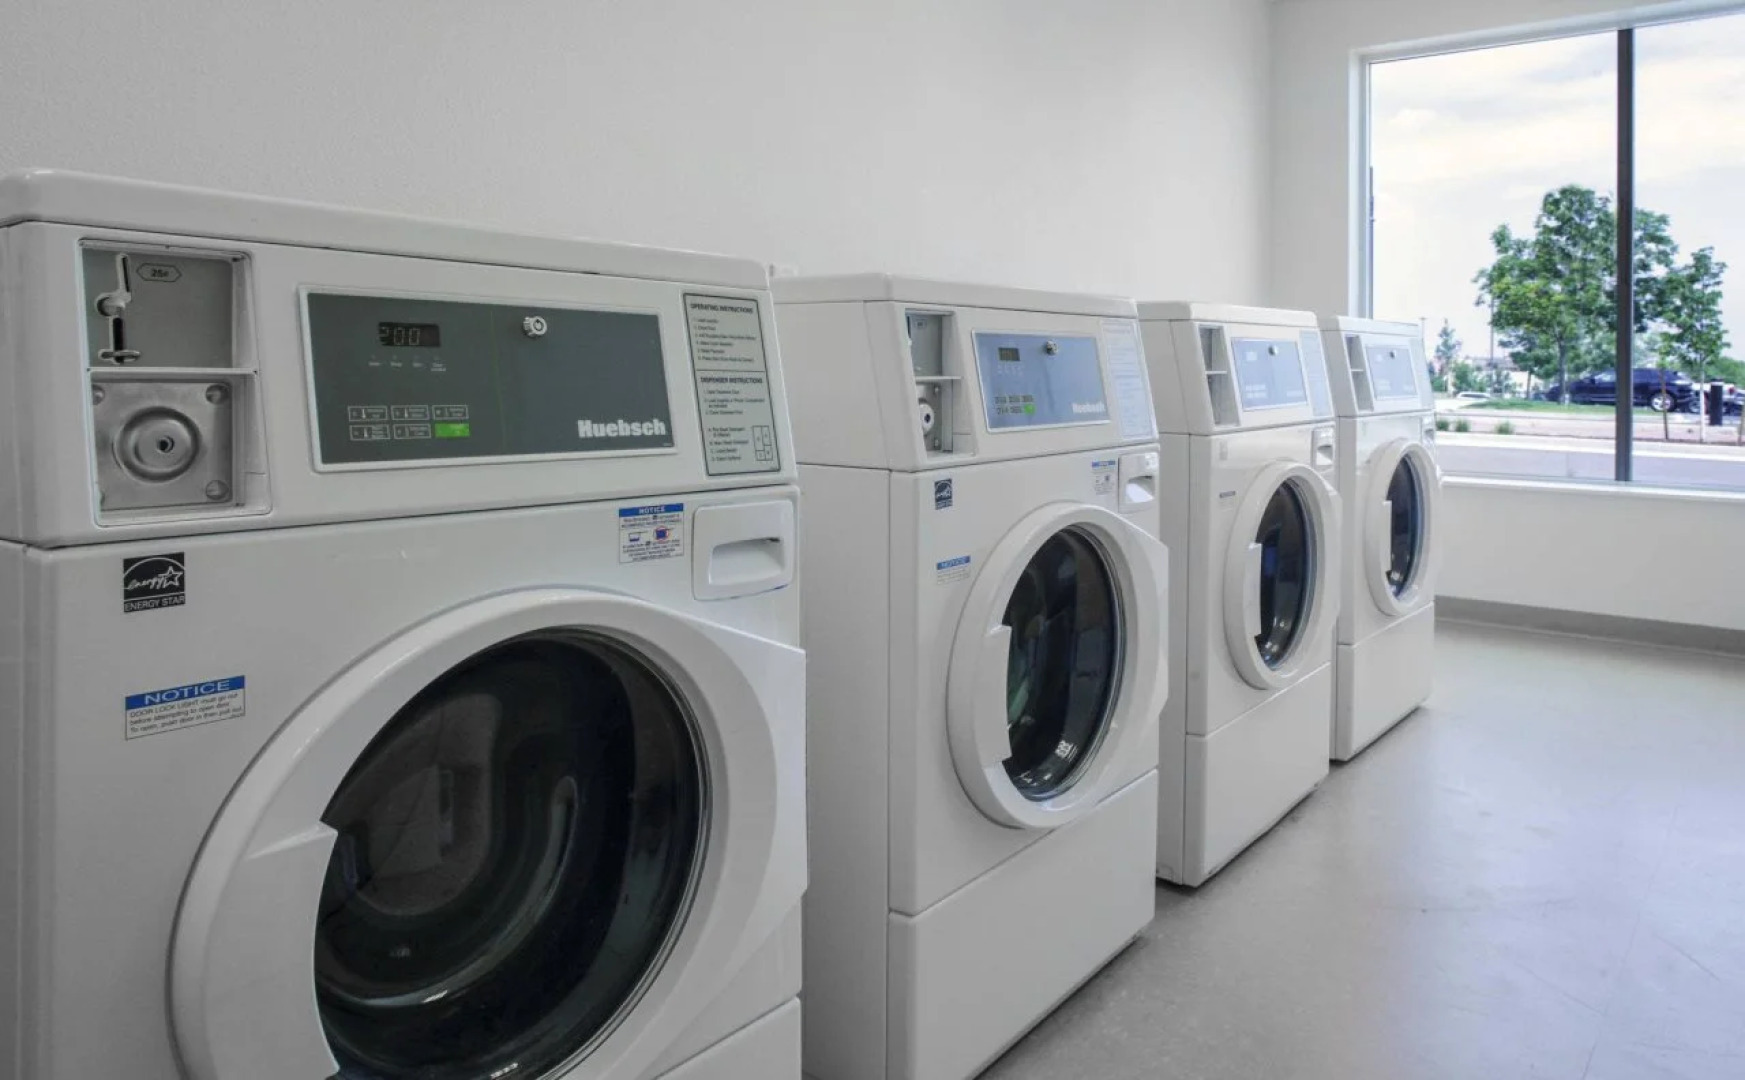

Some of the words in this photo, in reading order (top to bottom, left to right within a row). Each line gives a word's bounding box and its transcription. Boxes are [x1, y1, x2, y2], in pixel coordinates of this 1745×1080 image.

[578, 419, 666, 438] Huebsch
[638, 505, 666, 515] NOTICE
[125, 599, 159, 611] ENERGY
[162, 596, 185, 607] STAR
[144, 680, 230, 705] NOTICE
[130, 708, 154, 718] DOOR
[155, 705, 176, 714] LOCK
[130, 716, 152, 726] before
